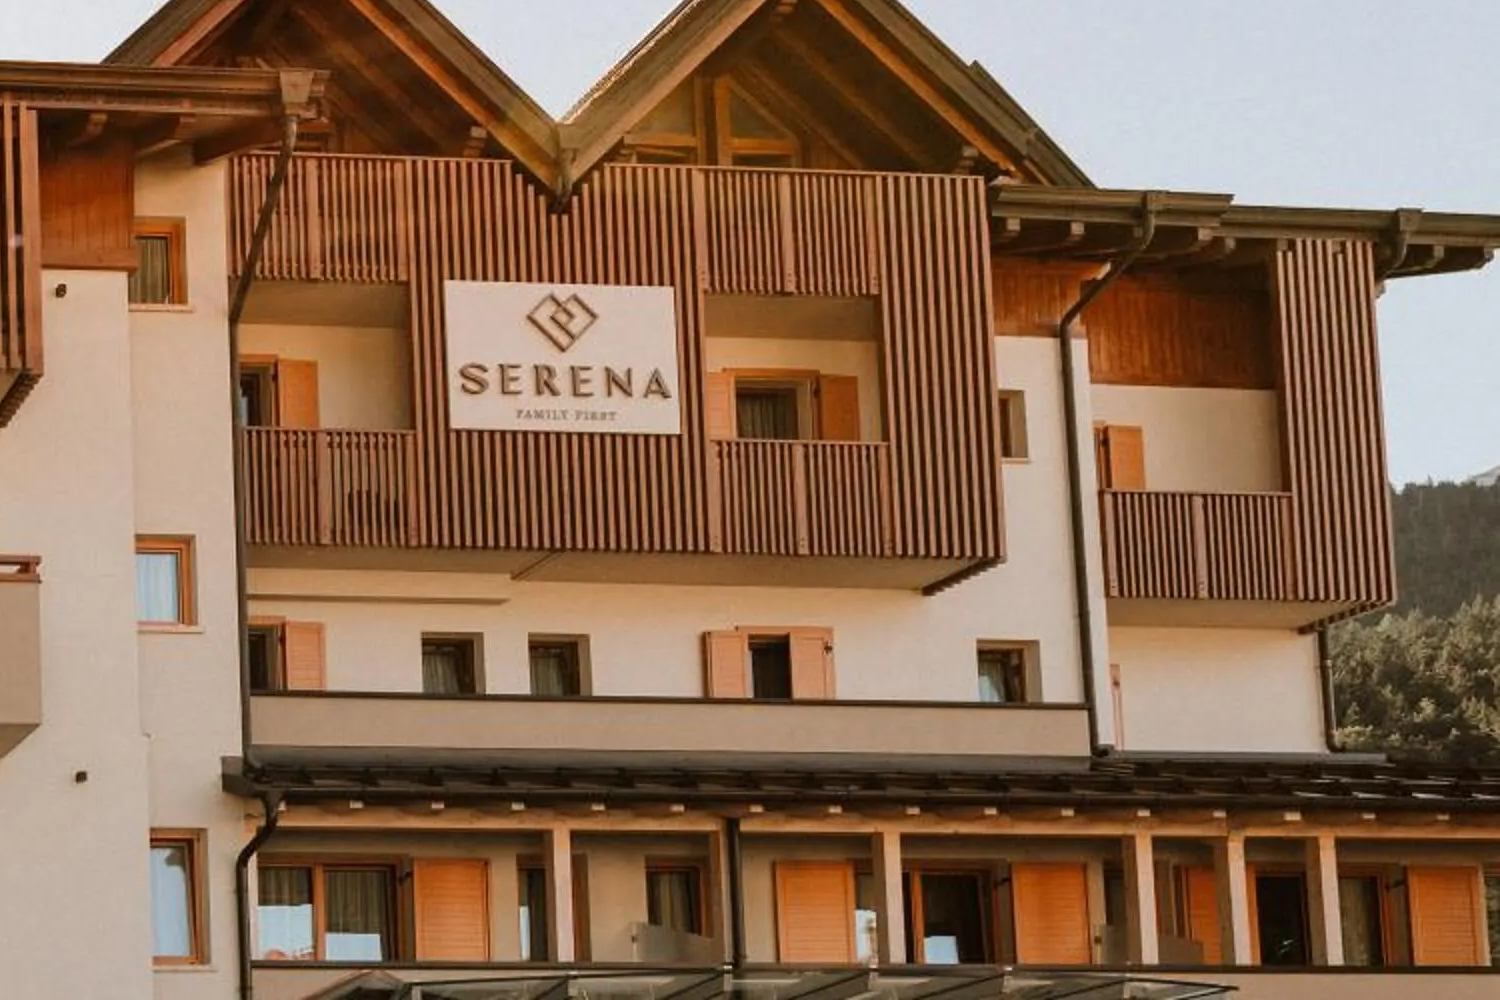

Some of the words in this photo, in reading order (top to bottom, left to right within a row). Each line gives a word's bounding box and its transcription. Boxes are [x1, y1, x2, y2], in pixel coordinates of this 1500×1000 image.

[458, 362, 673, 399] SERENA
[516, 408, 570, 421] FAMILY
[575, 409, 617, 422] FIRST
